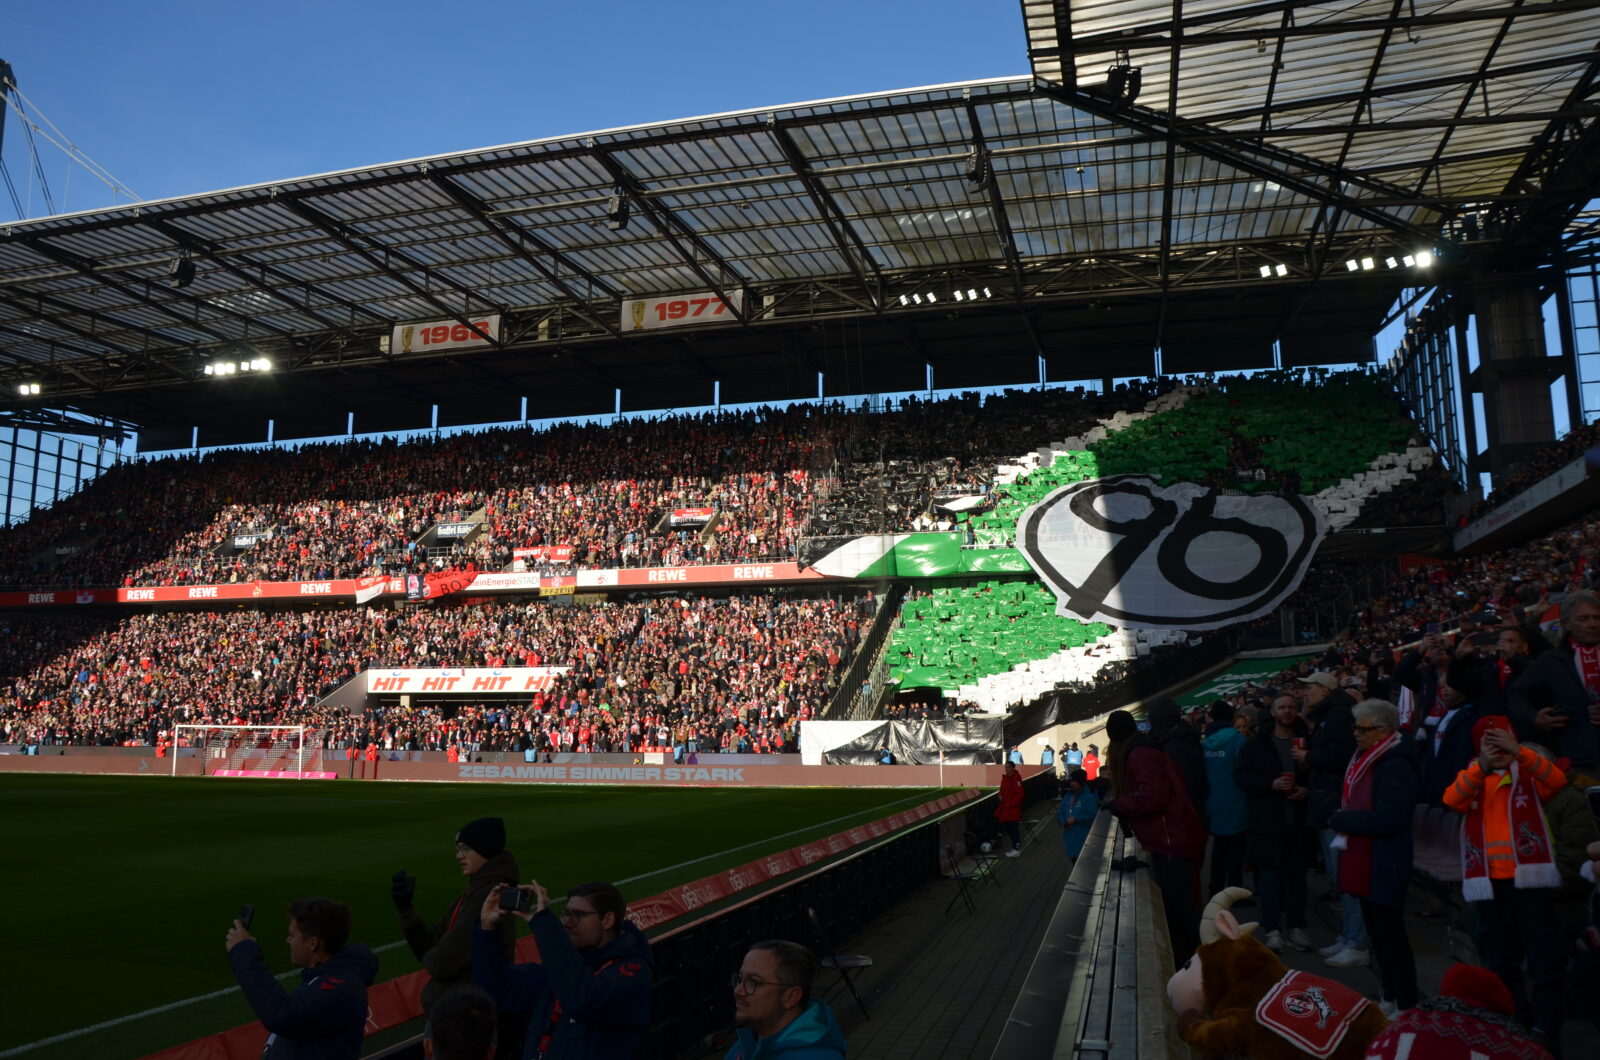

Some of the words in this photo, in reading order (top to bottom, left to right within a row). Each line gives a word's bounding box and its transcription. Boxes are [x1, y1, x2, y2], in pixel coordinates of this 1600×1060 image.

[654, 295, 732, 321] 1977
[648, 569, 687, 582] REWE
[734, 566, 774, 579] REWE
[126, 589, 155, 600] REWE
[188, 586, 218, 598] REWE
[300, 582, 332, 594] REWE
[28, 593, 55, 604] REWE
[373, 677, 410, 691] HIT
[421, 677, 460, 691] HIT
[471, 676, 512, 690] HIT
[459, 765, 566, 779] ZESAMME
[570, 766, 661, 781] SIMMER
[664, 768, 745, 782] STARK
